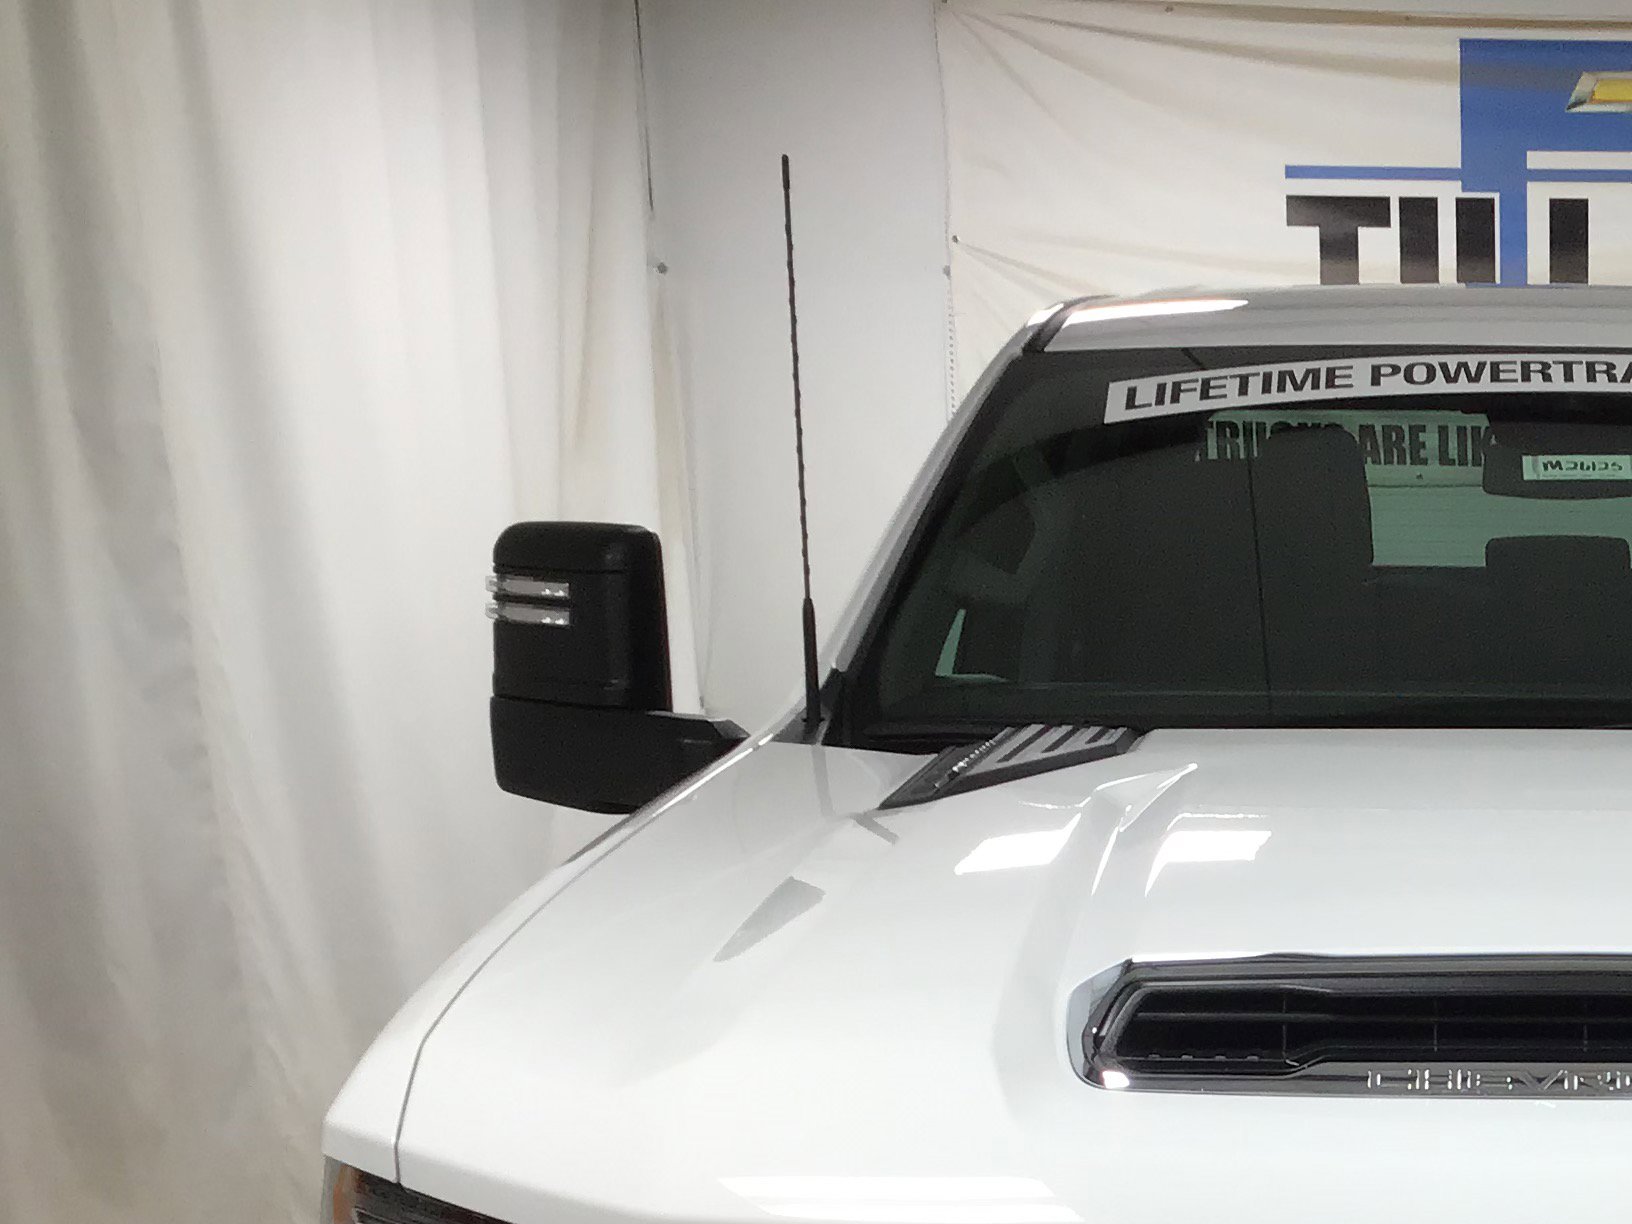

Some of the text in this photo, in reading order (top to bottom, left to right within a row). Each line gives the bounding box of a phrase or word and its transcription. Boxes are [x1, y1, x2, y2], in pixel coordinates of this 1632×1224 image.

[1123, 366, 1353, 411] LIFETIME
[1358, 423, 1429, 465] ARE
[1438, 424, 1495, 467] LIK
